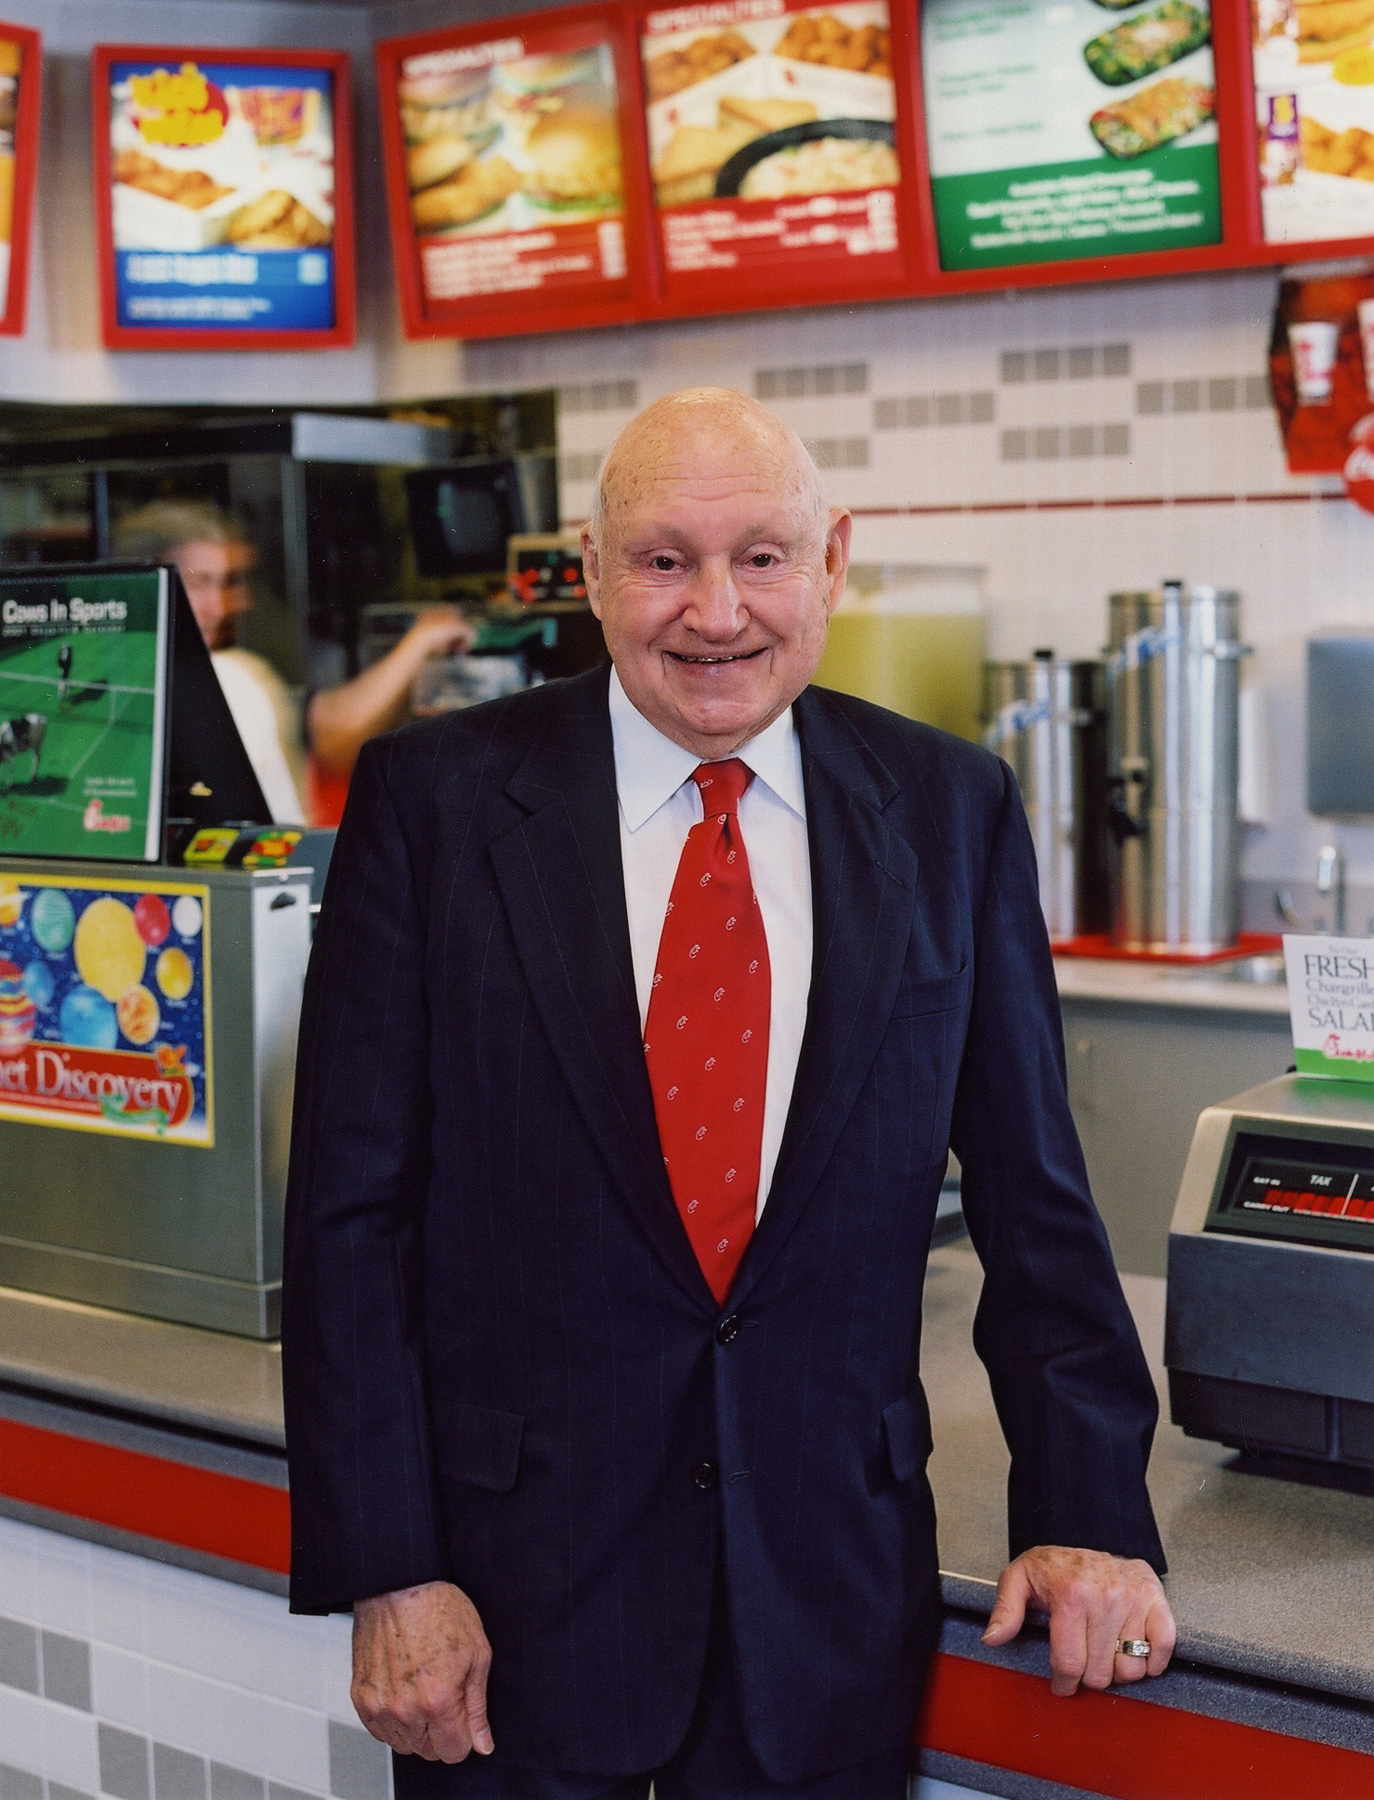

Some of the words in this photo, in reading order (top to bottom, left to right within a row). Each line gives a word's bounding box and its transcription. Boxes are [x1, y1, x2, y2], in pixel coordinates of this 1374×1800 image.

[3, 599, 49, 623] Cows
[50, 598, 67, 622] In
[69, 597, 128, 625] Sports
[1308, 1007, 1374, 1032] SALA
[36, 1050, 182, 1123] Discovery
[1310, 1174, 1333, 1187] TAX
